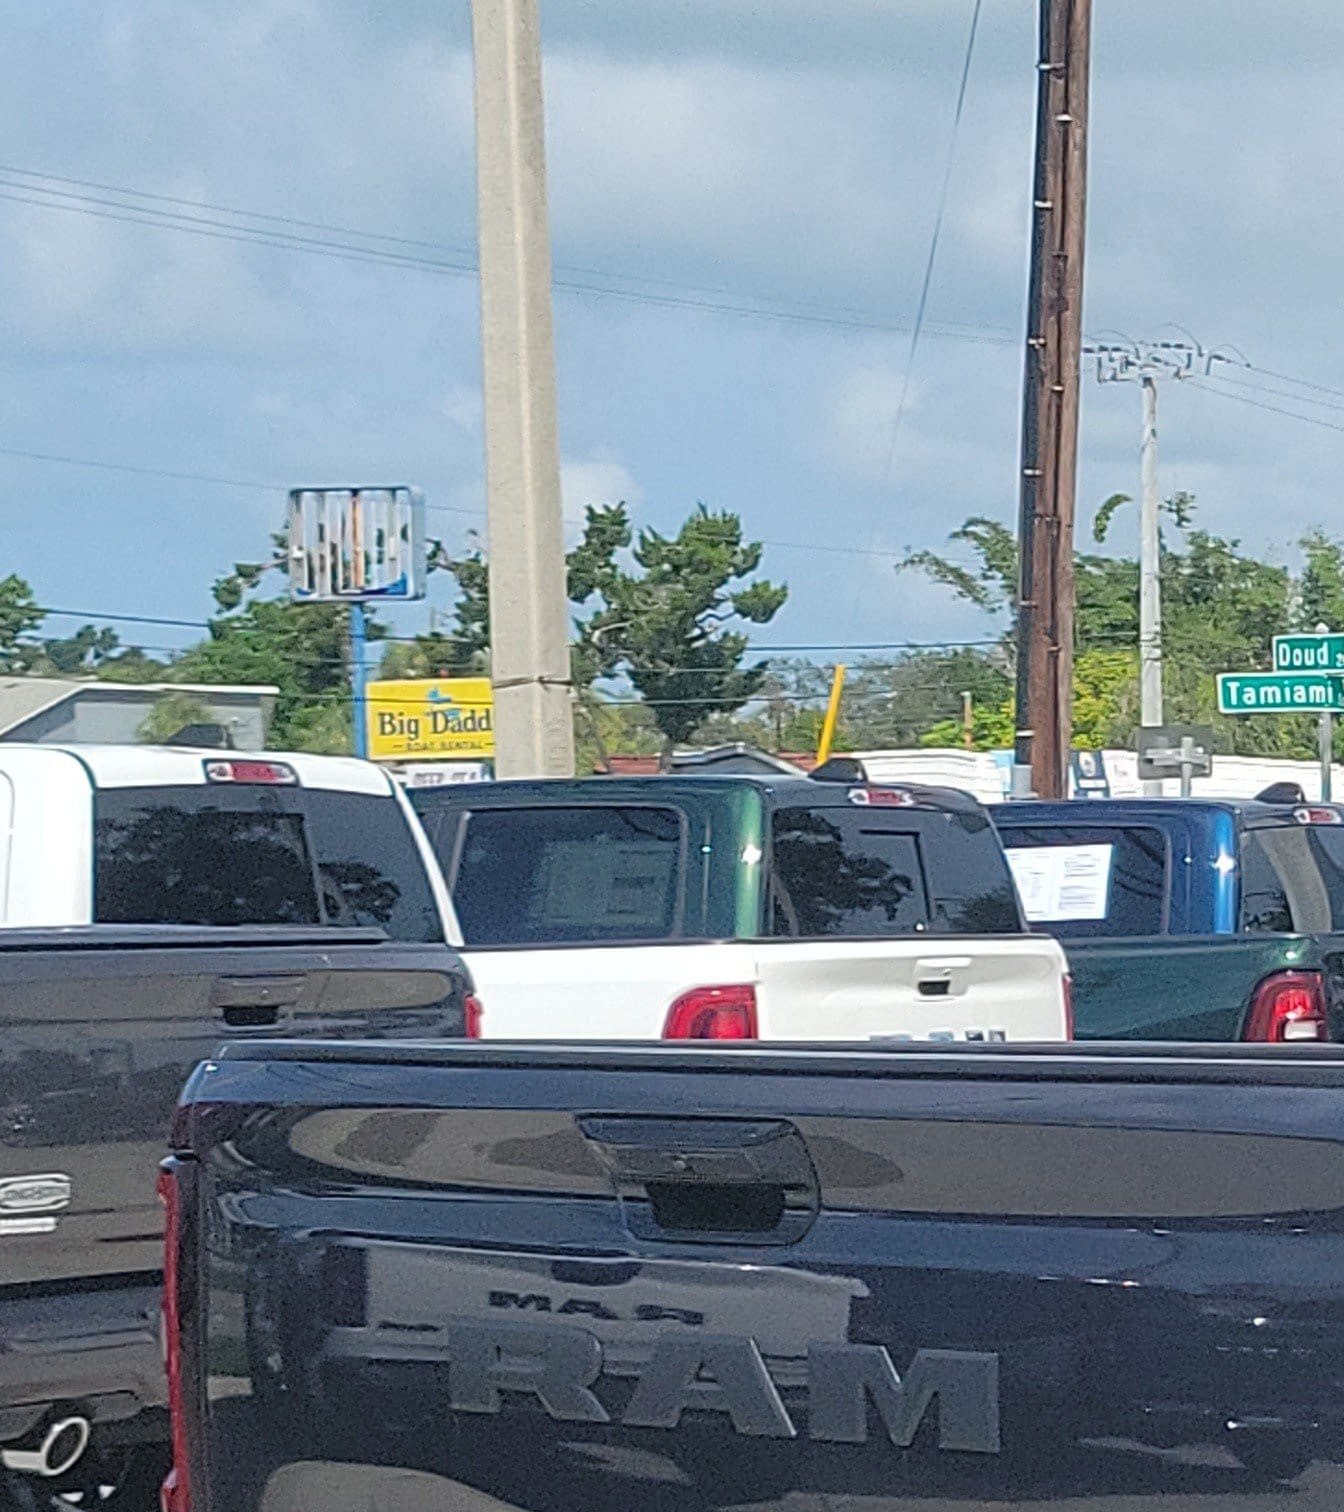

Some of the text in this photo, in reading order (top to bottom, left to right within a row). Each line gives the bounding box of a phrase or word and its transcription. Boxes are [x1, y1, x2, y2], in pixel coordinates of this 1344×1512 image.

[1278, 641, 1329, 667] Doud
[1226, 679, 1334, 706] Tamiami
[378, 708, 493, 741] Big Dadd
[447, 1315, 1001, 1454] RAM
